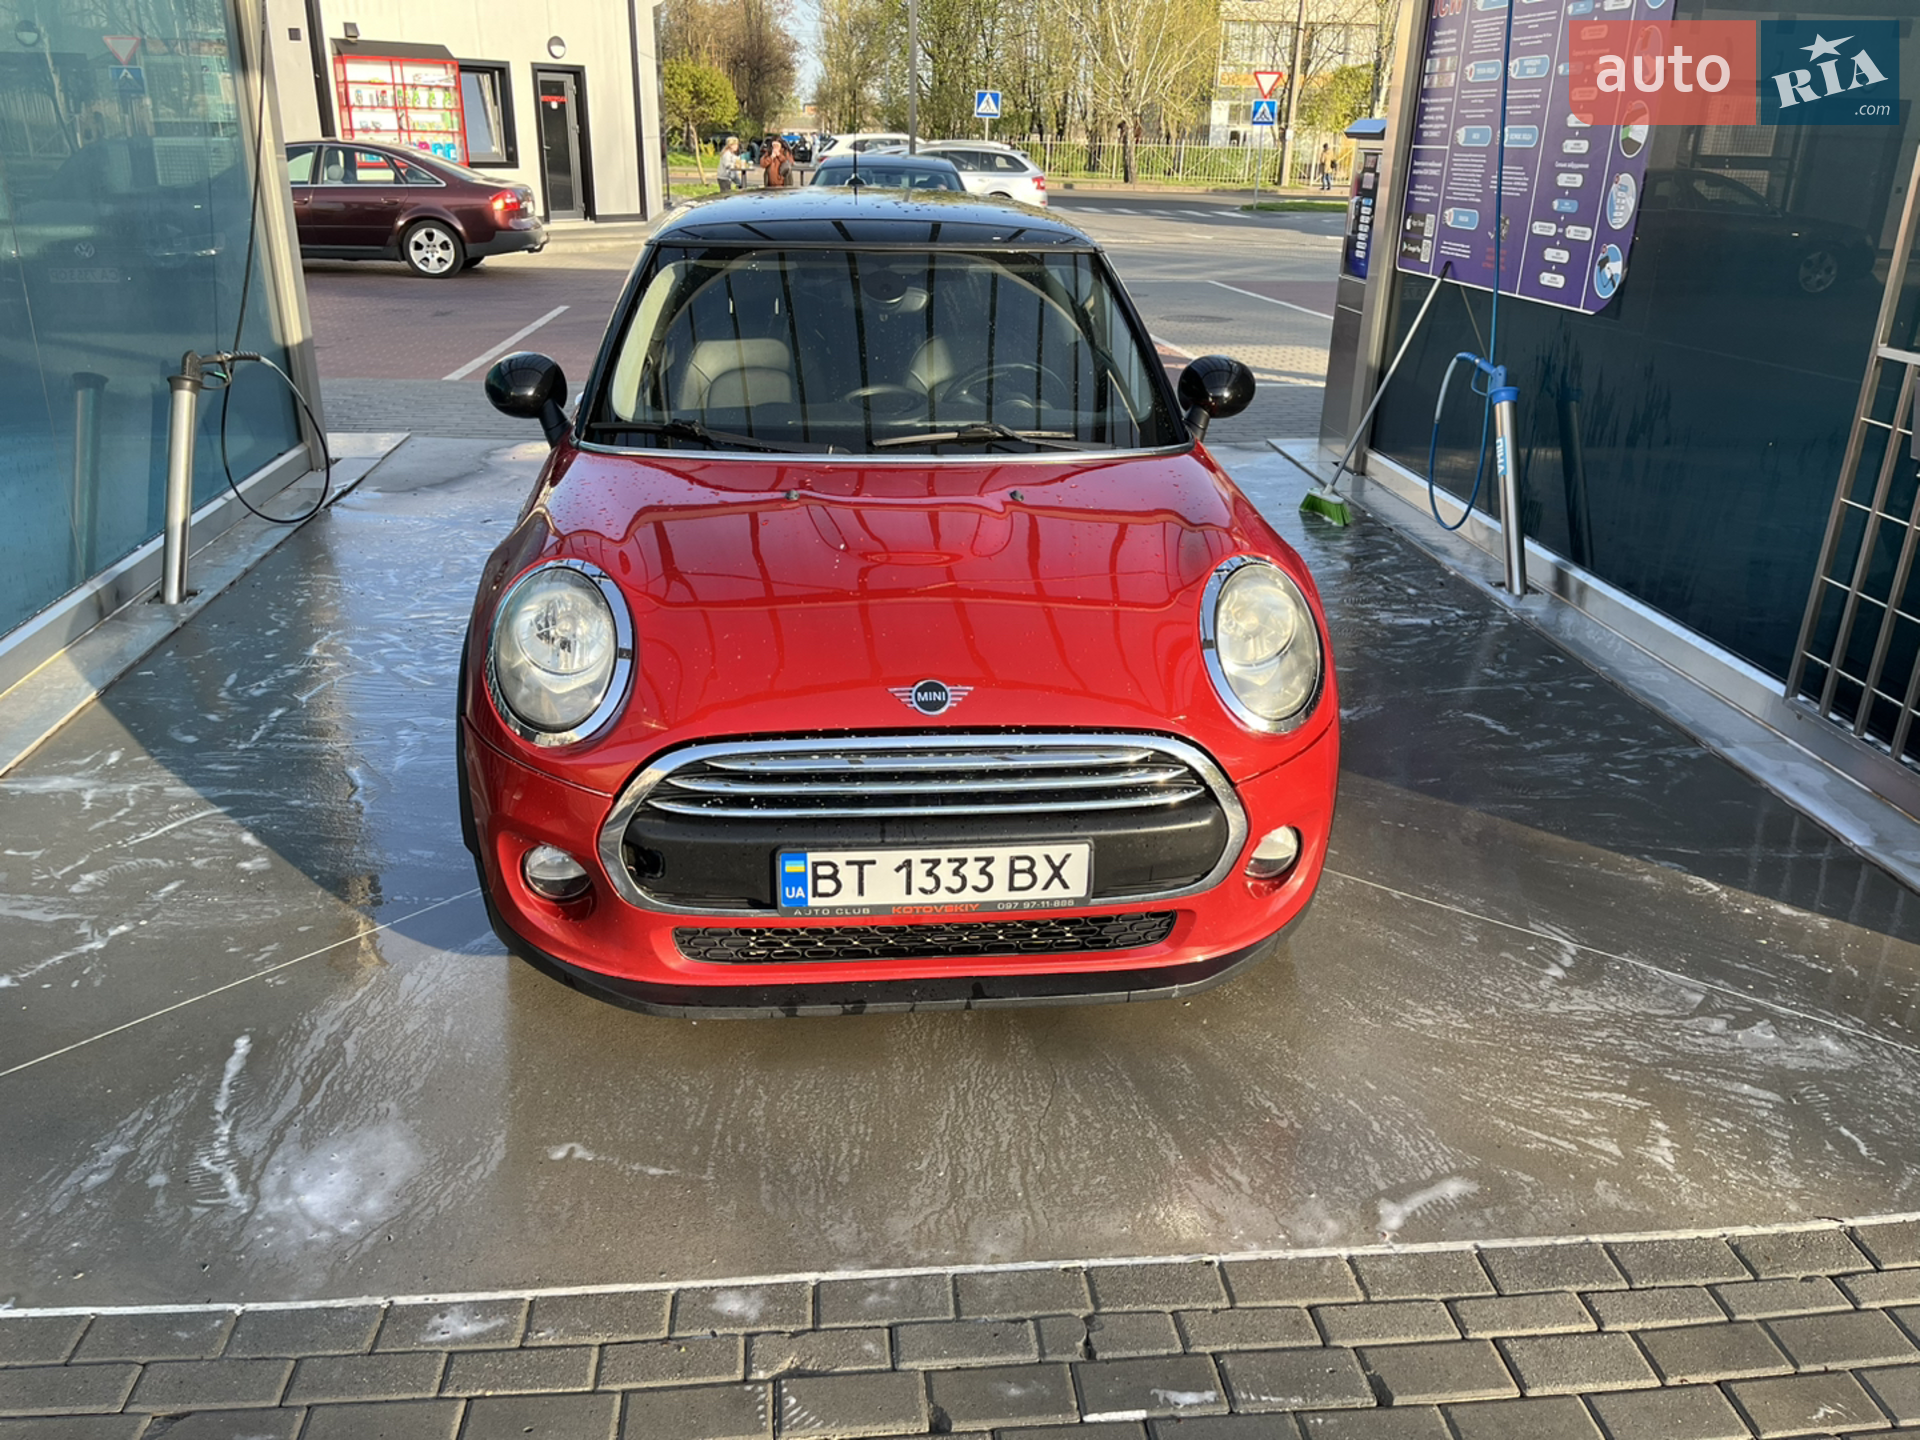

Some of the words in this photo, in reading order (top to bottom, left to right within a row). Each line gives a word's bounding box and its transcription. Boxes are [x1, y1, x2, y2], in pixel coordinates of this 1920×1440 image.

[916, 691, 946, 702] MINI
[811, 858, 877, 898] BT
[894, 855, 996, 896] 1333
[1008, 853, 1072, 892] BX
[785, 886, 805, 899] UA
[793, 908, 830, 916] AUTO
[835, 907, 870, 915] CLUB
[891, 903, 980, 914] KOTOVSKIY
[997, 902, 1019, 910] 097
